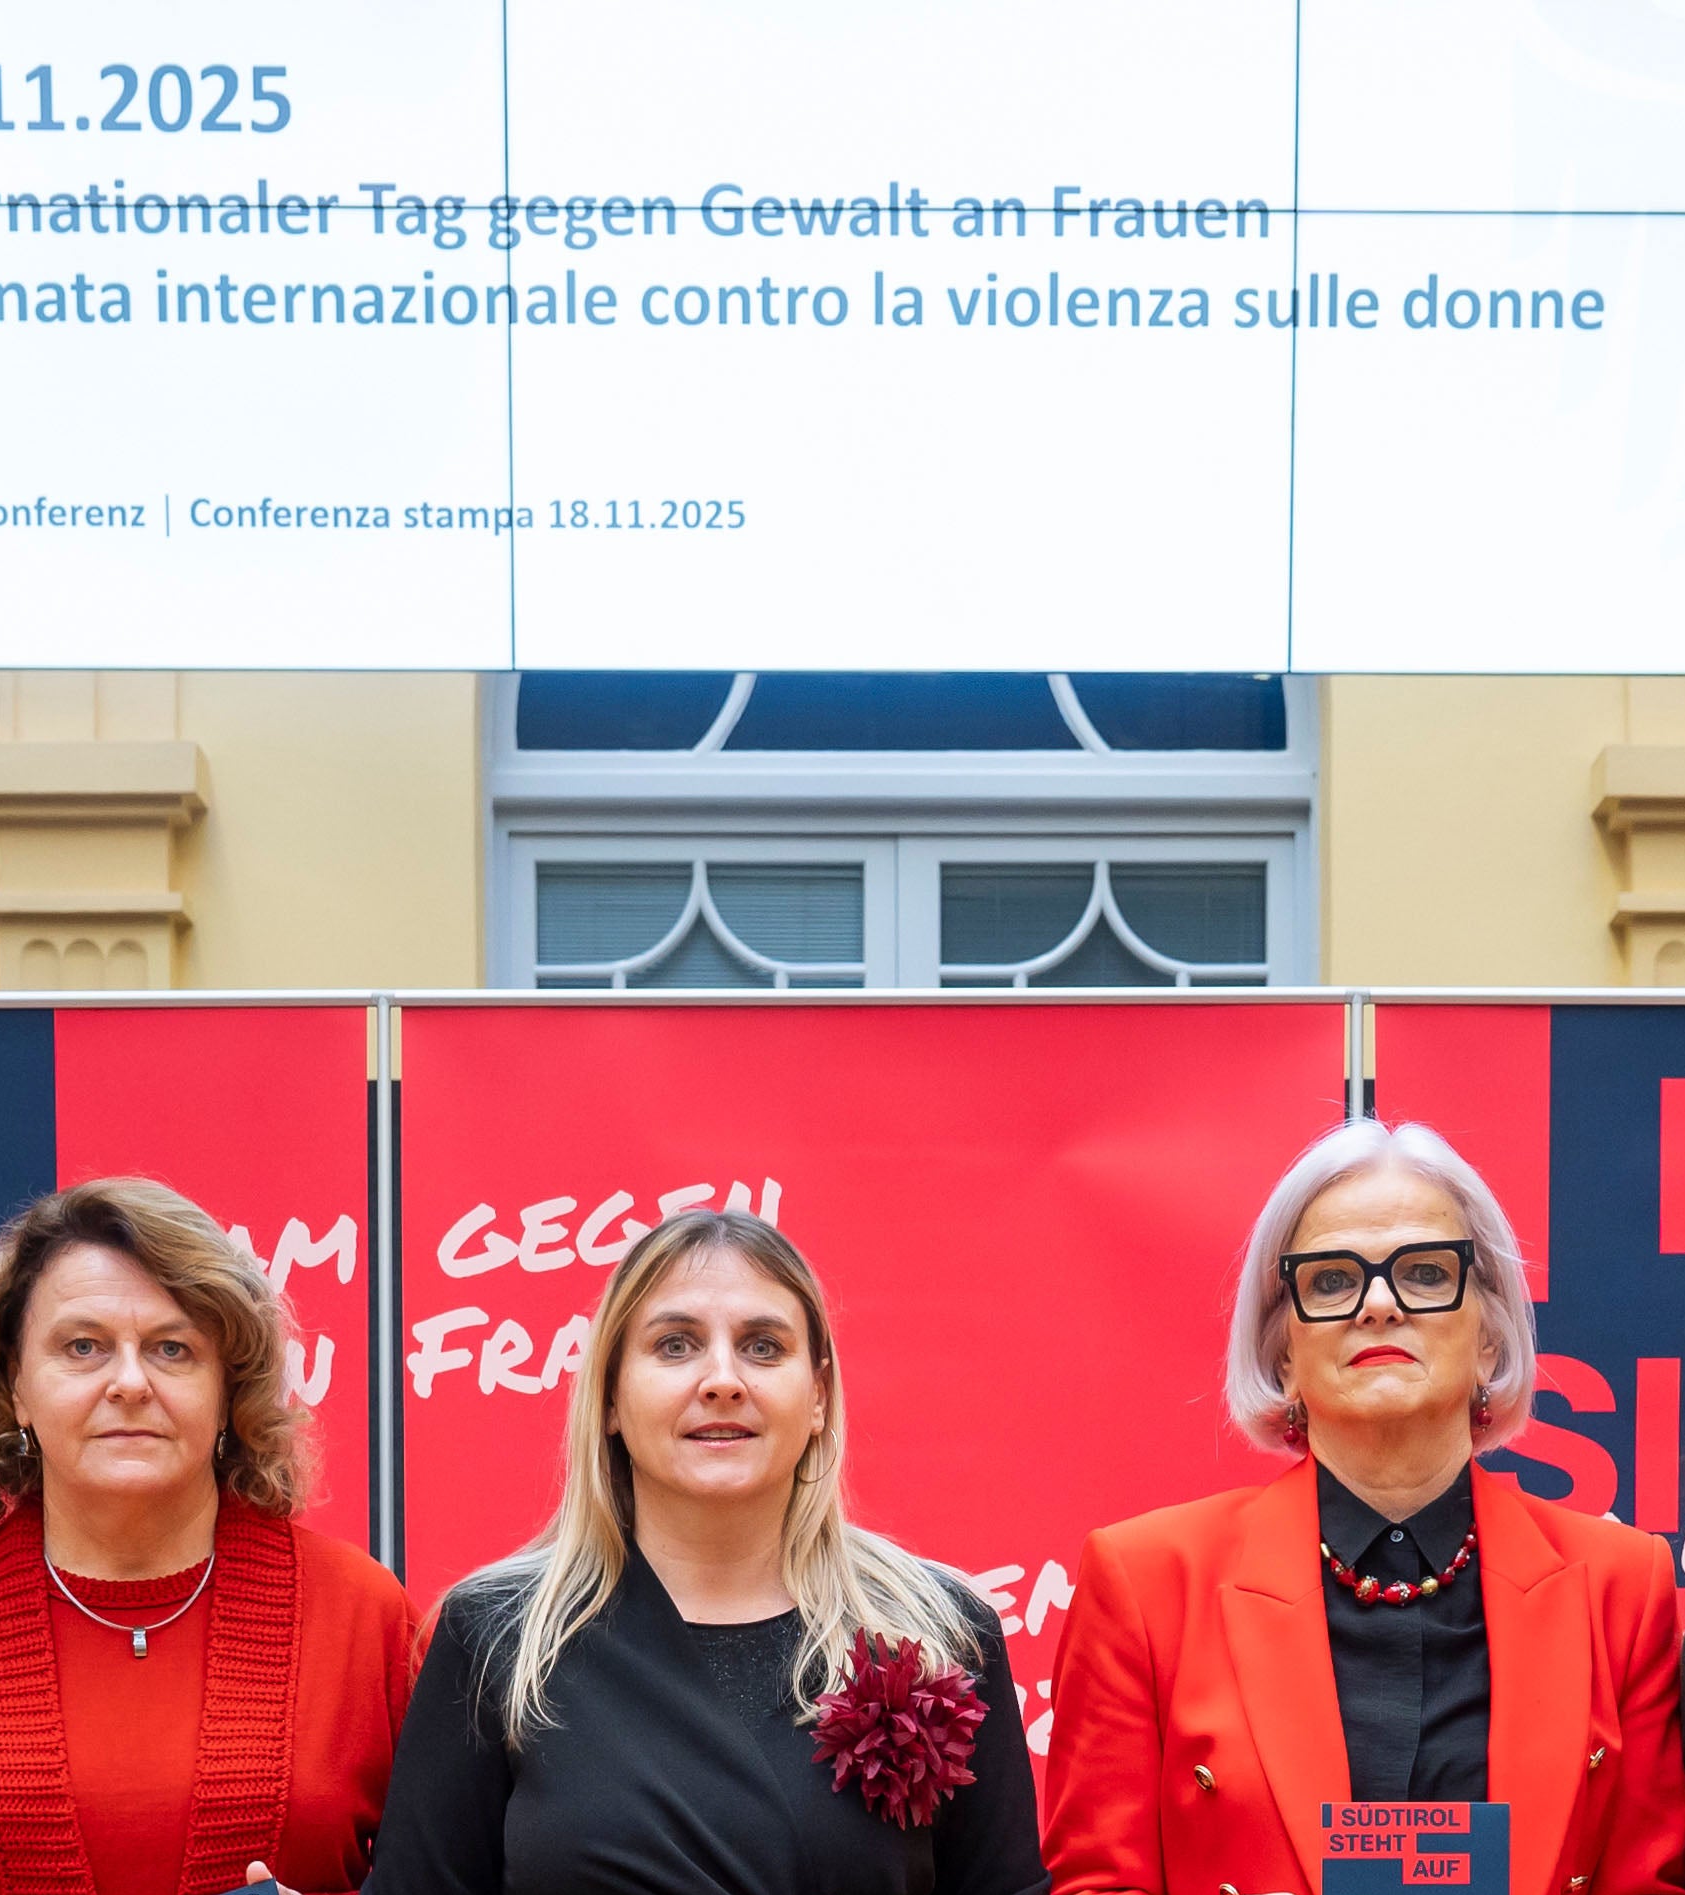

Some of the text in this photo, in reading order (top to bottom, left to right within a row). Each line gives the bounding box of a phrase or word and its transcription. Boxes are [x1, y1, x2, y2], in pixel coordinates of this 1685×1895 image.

[359, 182, 468, 251] Tag
[488, 192, 677, 251] gegen
[703, 182, 930, 238] Gewalt
[951, 196, 1028, 238] an
[1052, 185, 1272, 239] Frauen
[157, 269, 618, 326] internazionale
[642, 276, 849, 327] contro
[875, 271, 923, 327] la
[947, 272, 1210, 329] violenza
[1235, 273, 1380, 330] sulle
[1404, 274, 1605, 331] donne
[190, 497, 391, 530] Conferenza
[403, 502, 534, 536] stampa
[549, 499, 746, 530] 18.11.2025
[1492, 1353, 1681, 1533] SI
[1341, 1804, 1461, 1827] SÜDTIROL
[1329, 1833, 1407, 1852] STEHT
[1412, 1859, 1461, 1878] AUF
